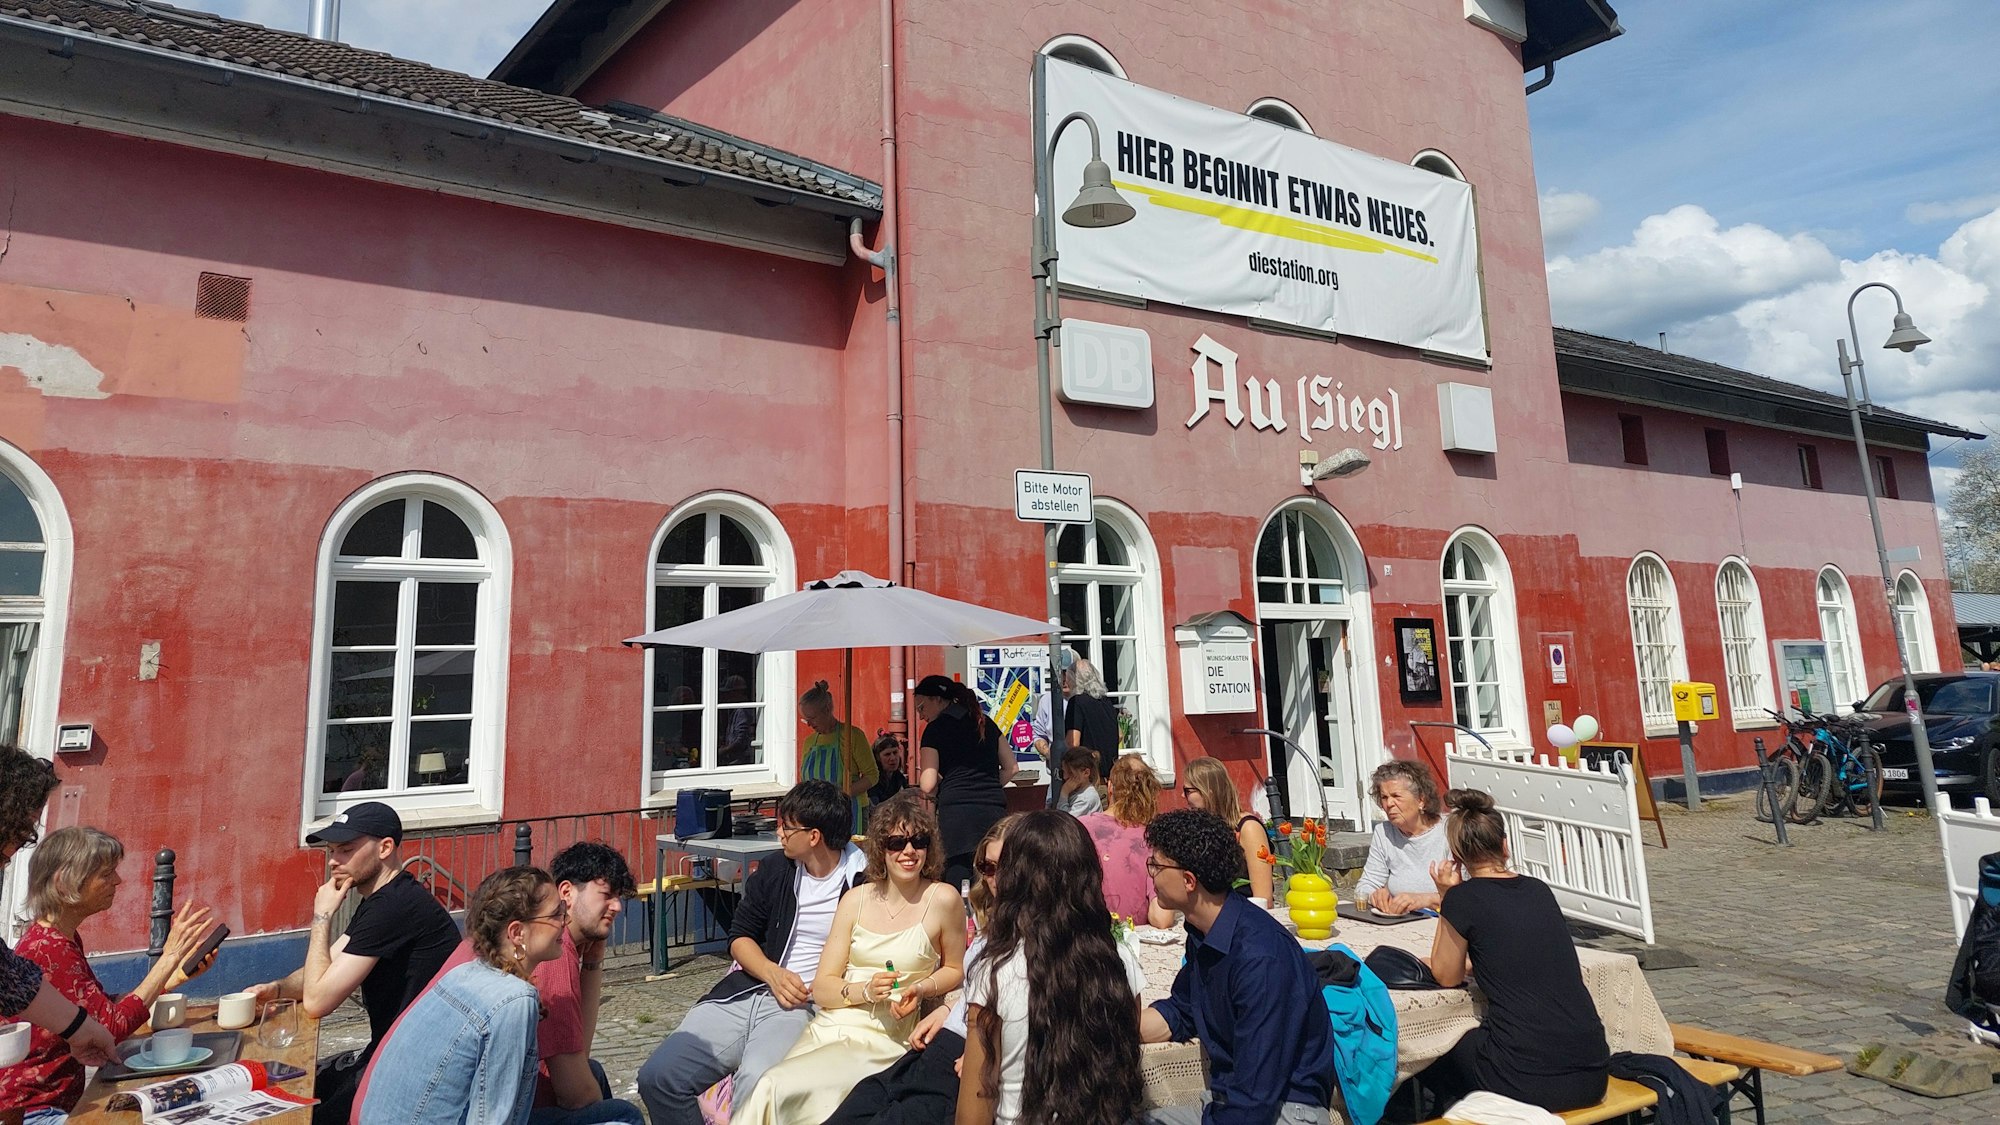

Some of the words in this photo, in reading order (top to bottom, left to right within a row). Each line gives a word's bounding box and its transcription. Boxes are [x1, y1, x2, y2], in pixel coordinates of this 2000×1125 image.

[1117, 130, 1174, 185] HIER
[1183, 148, 1279, 209] BEGINNT
[1288, 175, 1362, 228] ETWAS
[1367, 196, 1435, 247] NEUES.
[1248, 251, 1339, 291] diestation.org
[1073, 333, 1144, 393] DB
[1186, 333, 1288, 433] Au
[1024, 481, 1049, 494] Bitte
[1053, 483, 1083, 496] Motor
[1031, 499, 1080, 513] abstellen
[1207, 666, 1225, 677] DIE
[1209, 683, 1251, 694] STATION
[1016, 735, 1031, 744] VISA
[1887, 769, 1907, 778] 1806
